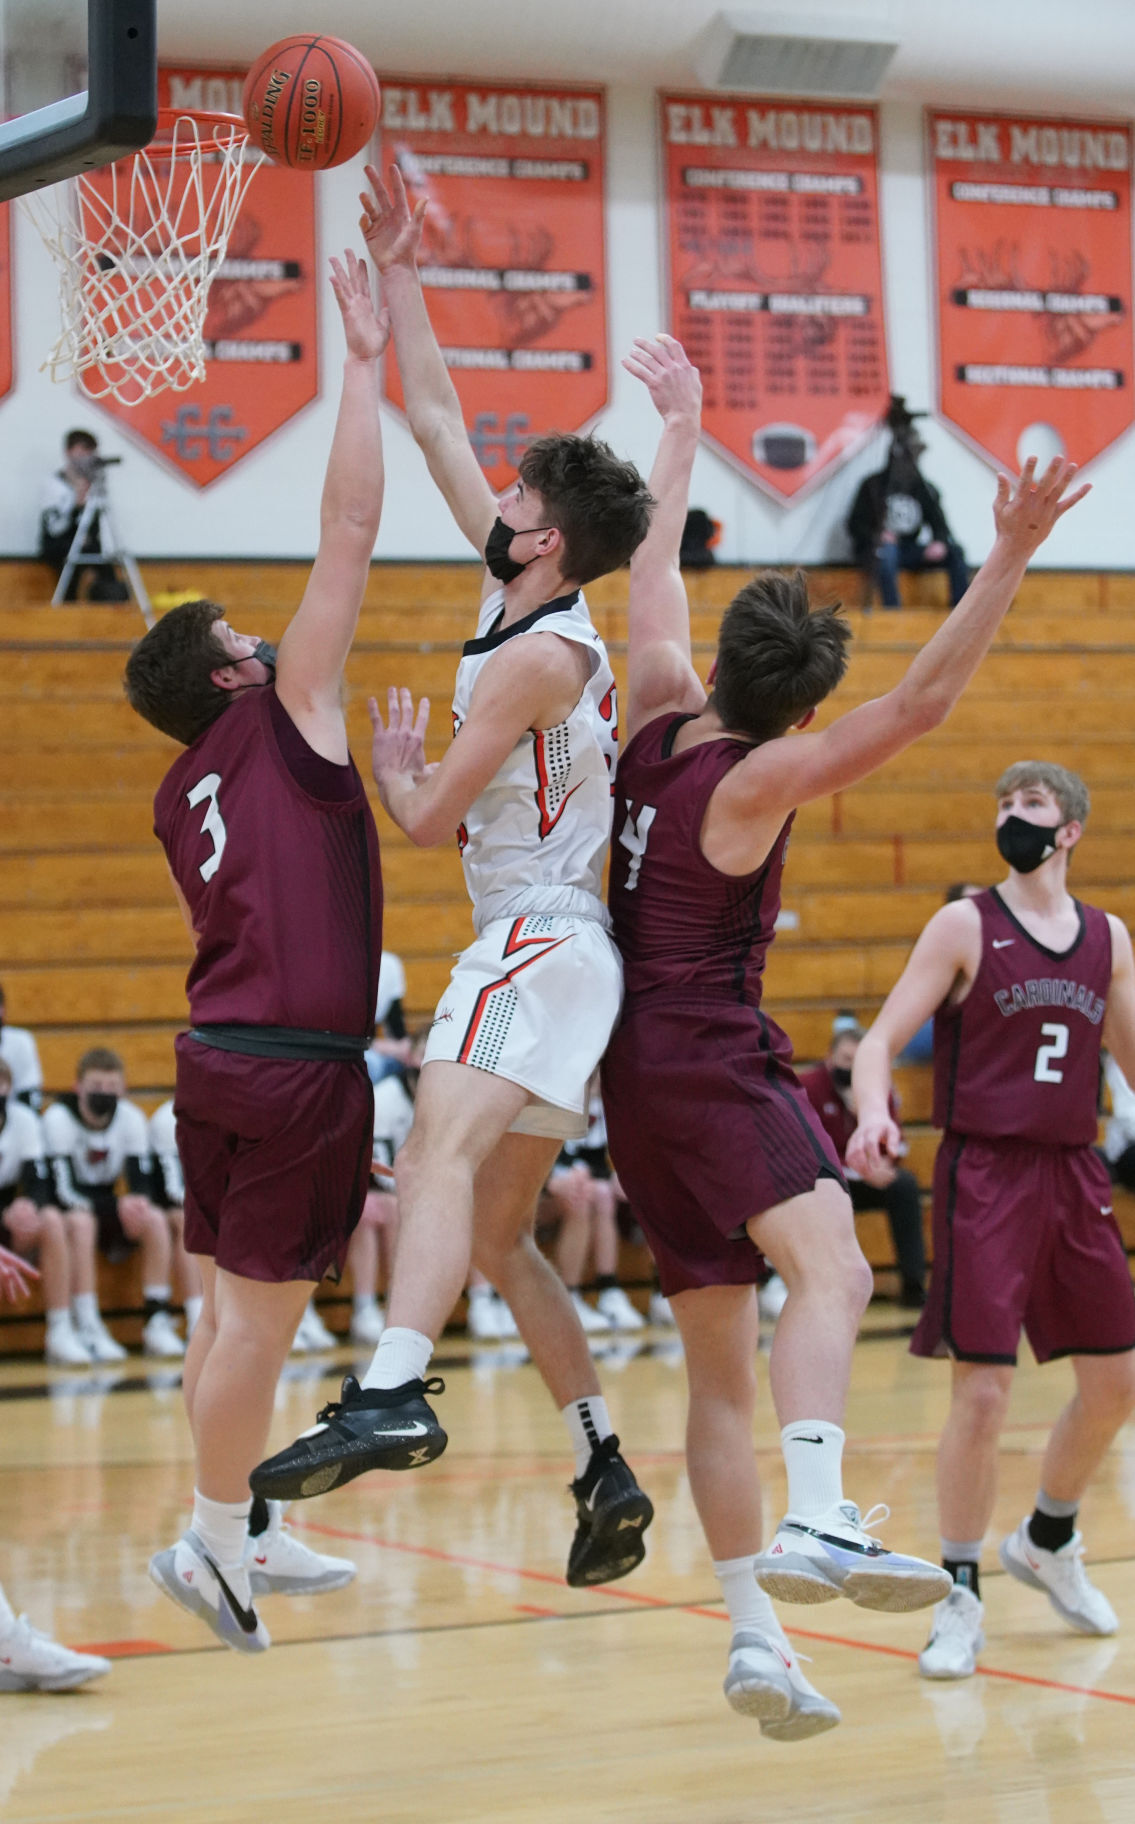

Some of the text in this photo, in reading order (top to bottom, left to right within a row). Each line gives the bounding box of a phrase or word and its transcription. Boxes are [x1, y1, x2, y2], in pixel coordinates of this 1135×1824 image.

[261, 69, 292, 157] SPALDING
[382, 88, 453, 132] ELK
[466, 93, 599, 139] MOUND
[667, 104, 872, 155] ELK MOUND
[935, 119, 1128, 172] ELK MOUND
[186, 772, 227, 883] 3
[993, 977, 1105, 1025] CARDINALS
[1033, 1022, 1070, 1084] 2
